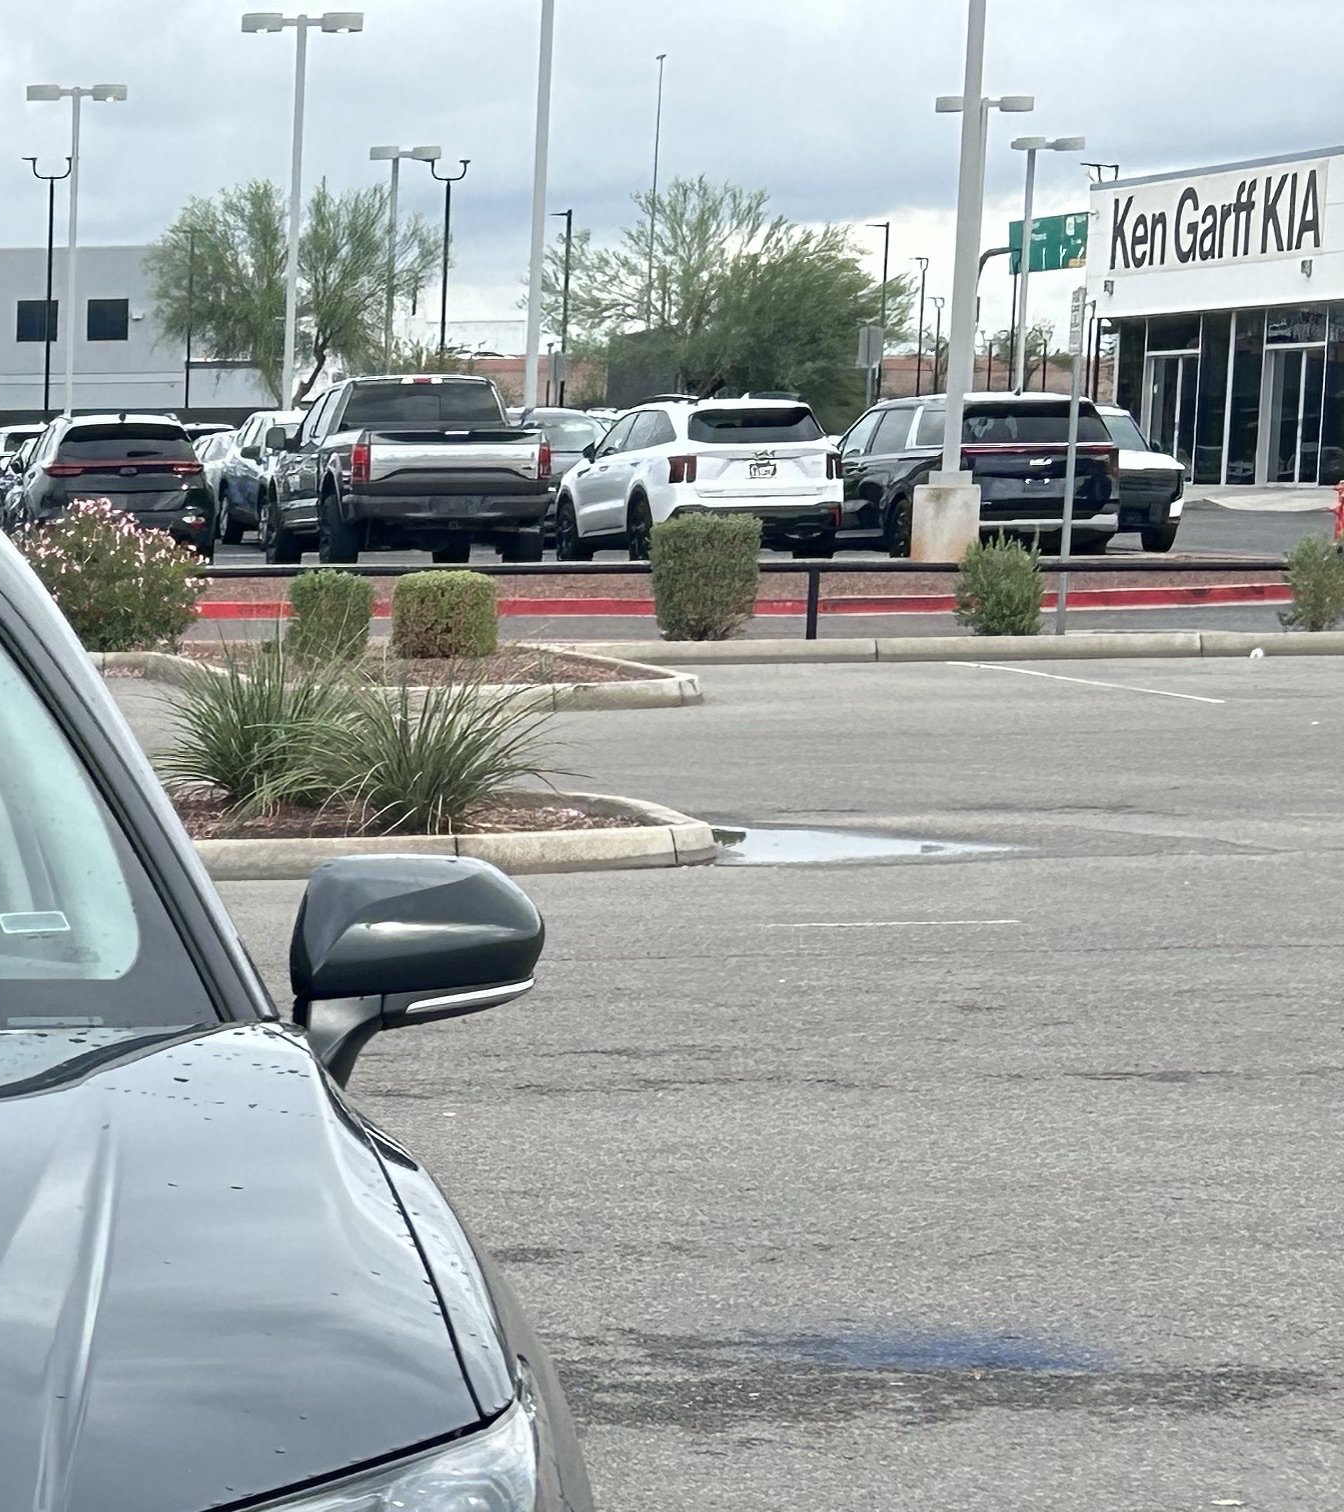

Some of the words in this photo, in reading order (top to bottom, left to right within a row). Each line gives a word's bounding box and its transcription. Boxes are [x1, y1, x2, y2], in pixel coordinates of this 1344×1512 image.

[1110, 195, 1167, 270] Ken
[1174, 178, 1257, 264] Garff
[1260, 169, 1321, 254] KIA
